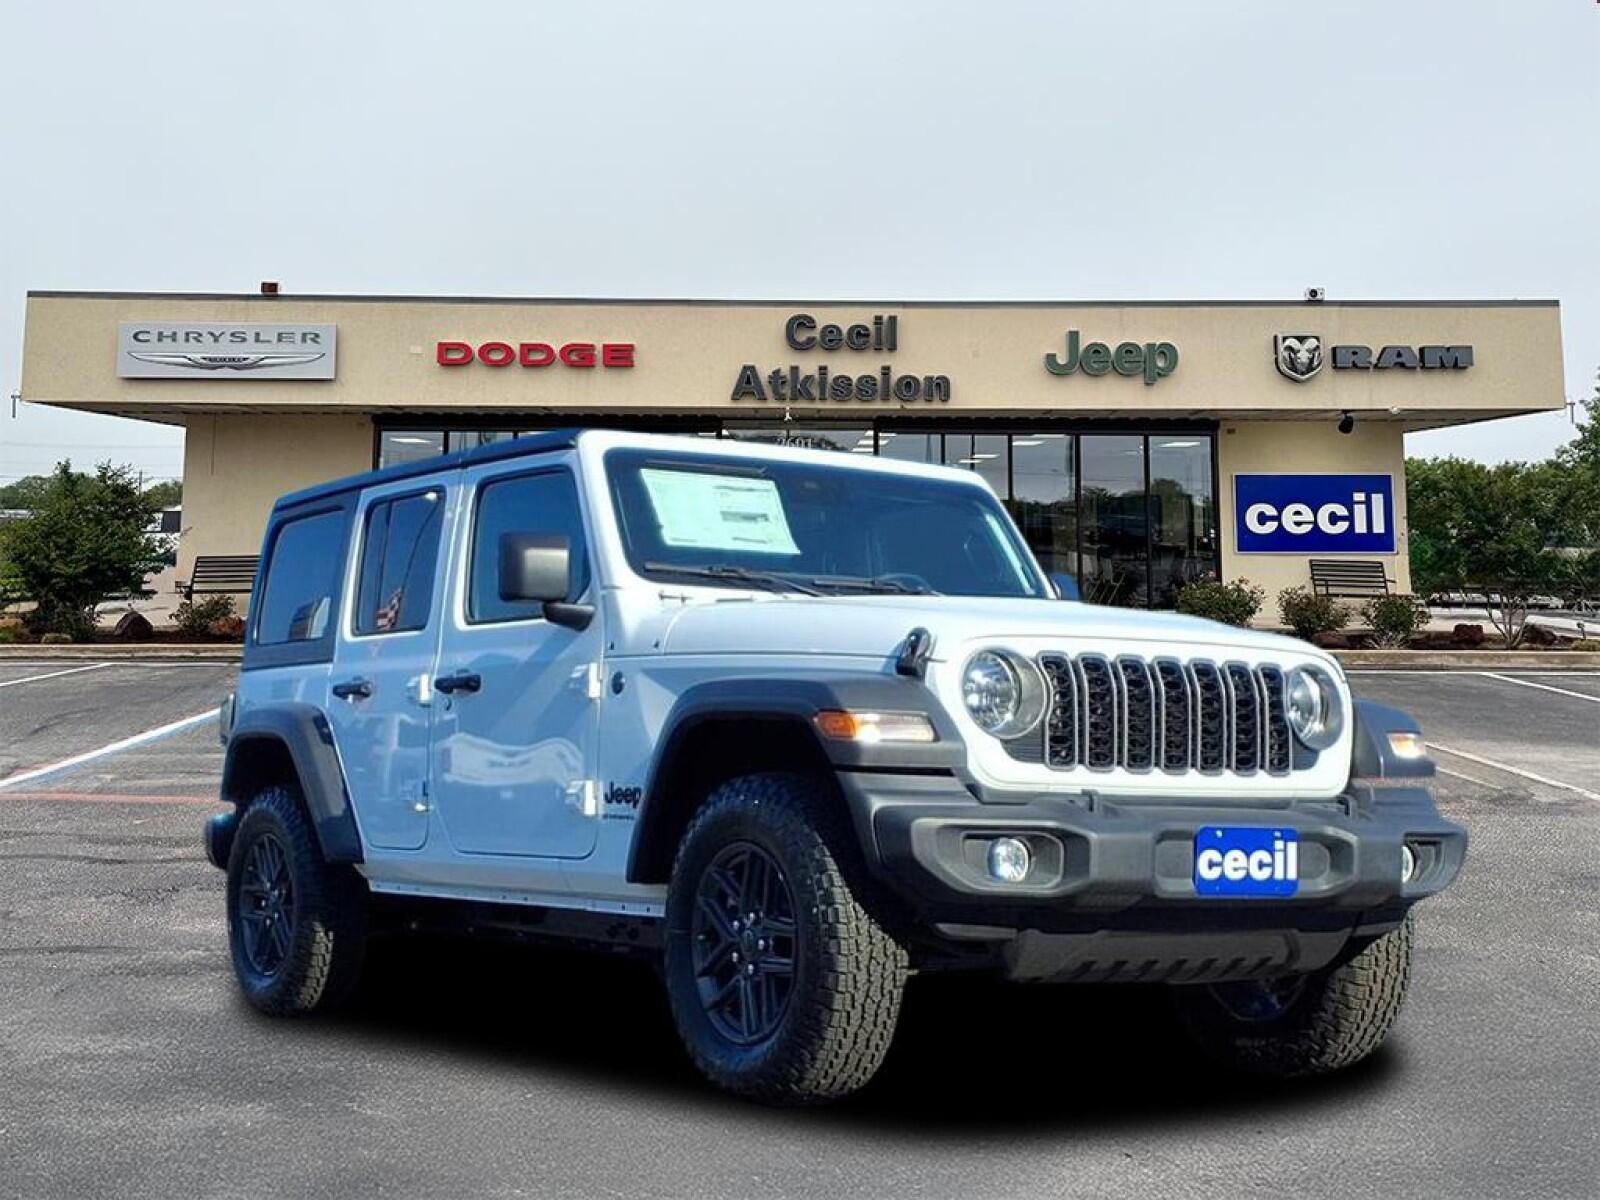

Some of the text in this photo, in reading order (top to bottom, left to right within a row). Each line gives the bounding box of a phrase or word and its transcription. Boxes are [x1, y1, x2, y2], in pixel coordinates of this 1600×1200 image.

[132, 330, 321, 344] CHRYSLER
[785, 313, 898, 350] Cecil
[437, 342, 634, 367] DODGE
[1046, 330, 1179, 386] Jeep
[1331, 345, 1474, 369] RAM
[731, 364, 951, 401] Atkission
[1245, 492, 1385, 534] cecil
[604, 780, 642, 809] Jeep
[1198, 840, 1298, 880] cecil
